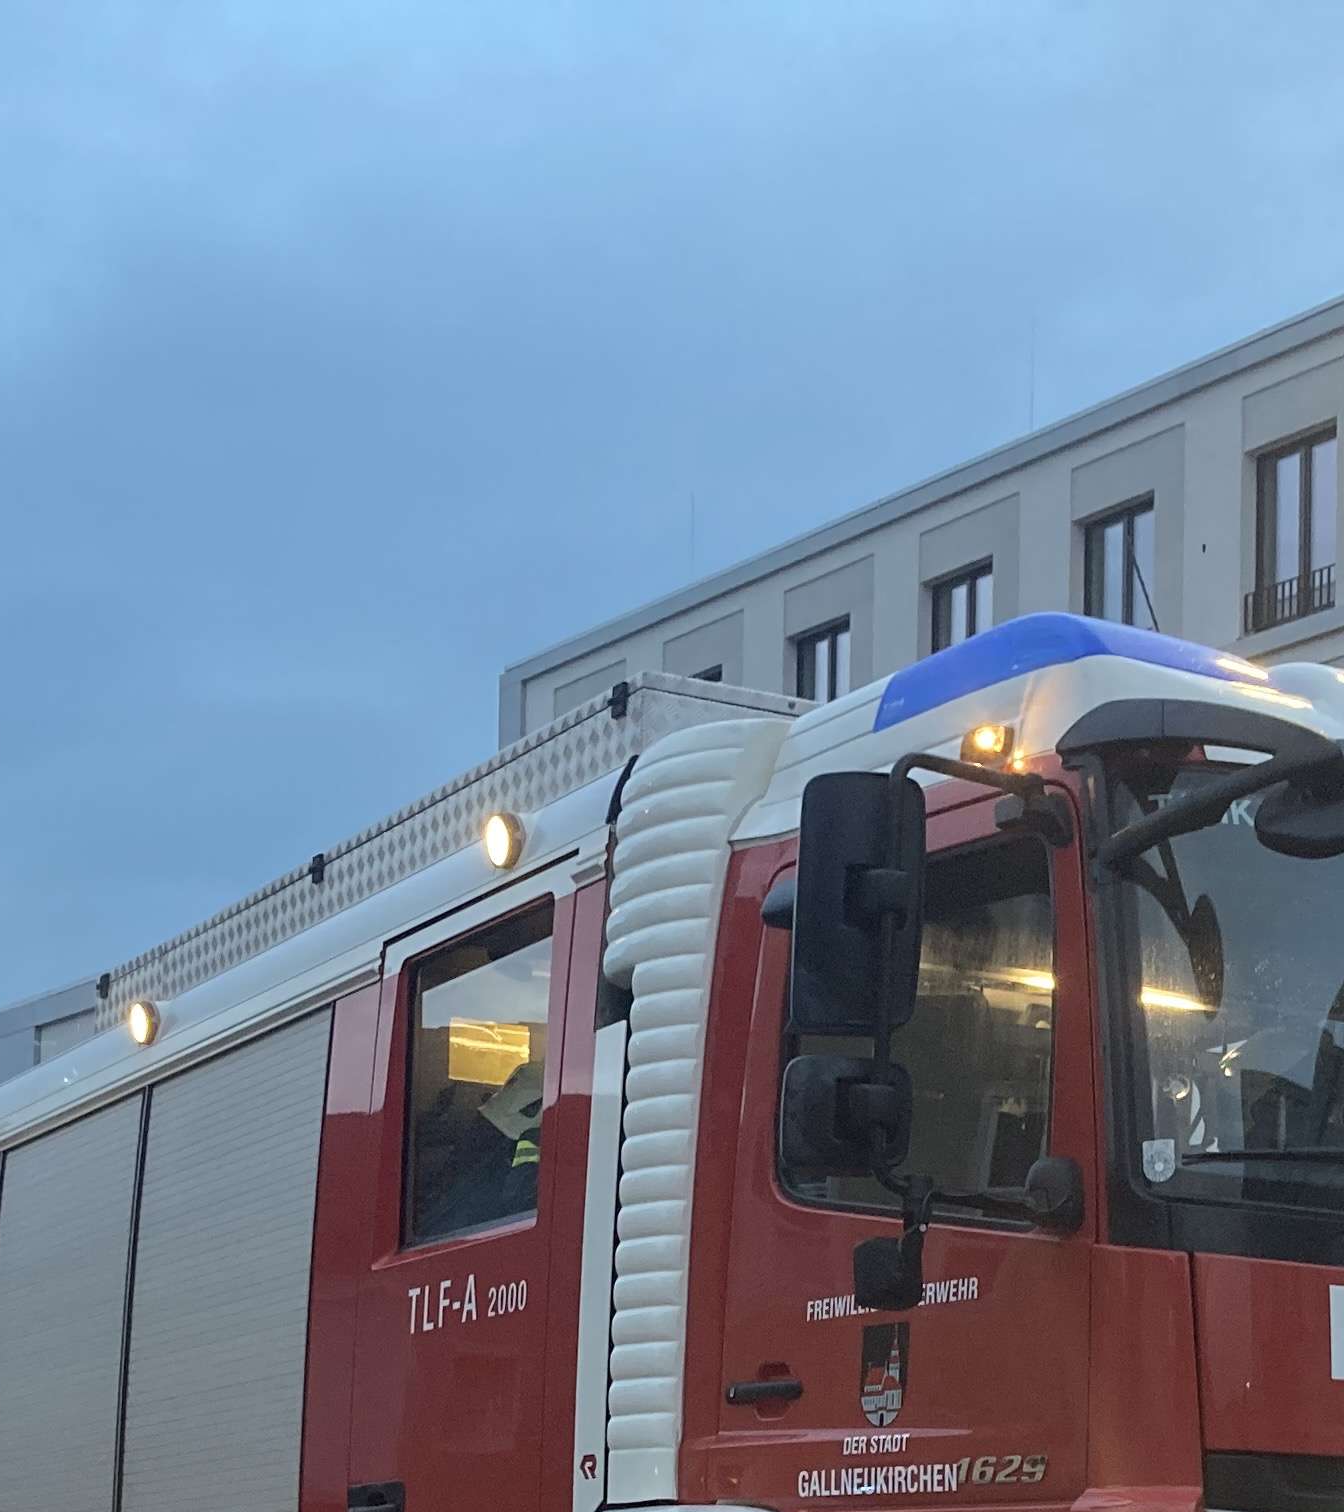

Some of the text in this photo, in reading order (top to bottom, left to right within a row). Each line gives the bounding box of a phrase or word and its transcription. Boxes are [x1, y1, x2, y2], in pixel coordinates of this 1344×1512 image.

[408, 1273, 527, 1334] TLF-A 2000
[843, 1433, 910, 1456] DER STADT
[798, 1463, 957, 1498] GALLNEUKIRCHEN
[956, 1454, 1048, 1485] 1629
